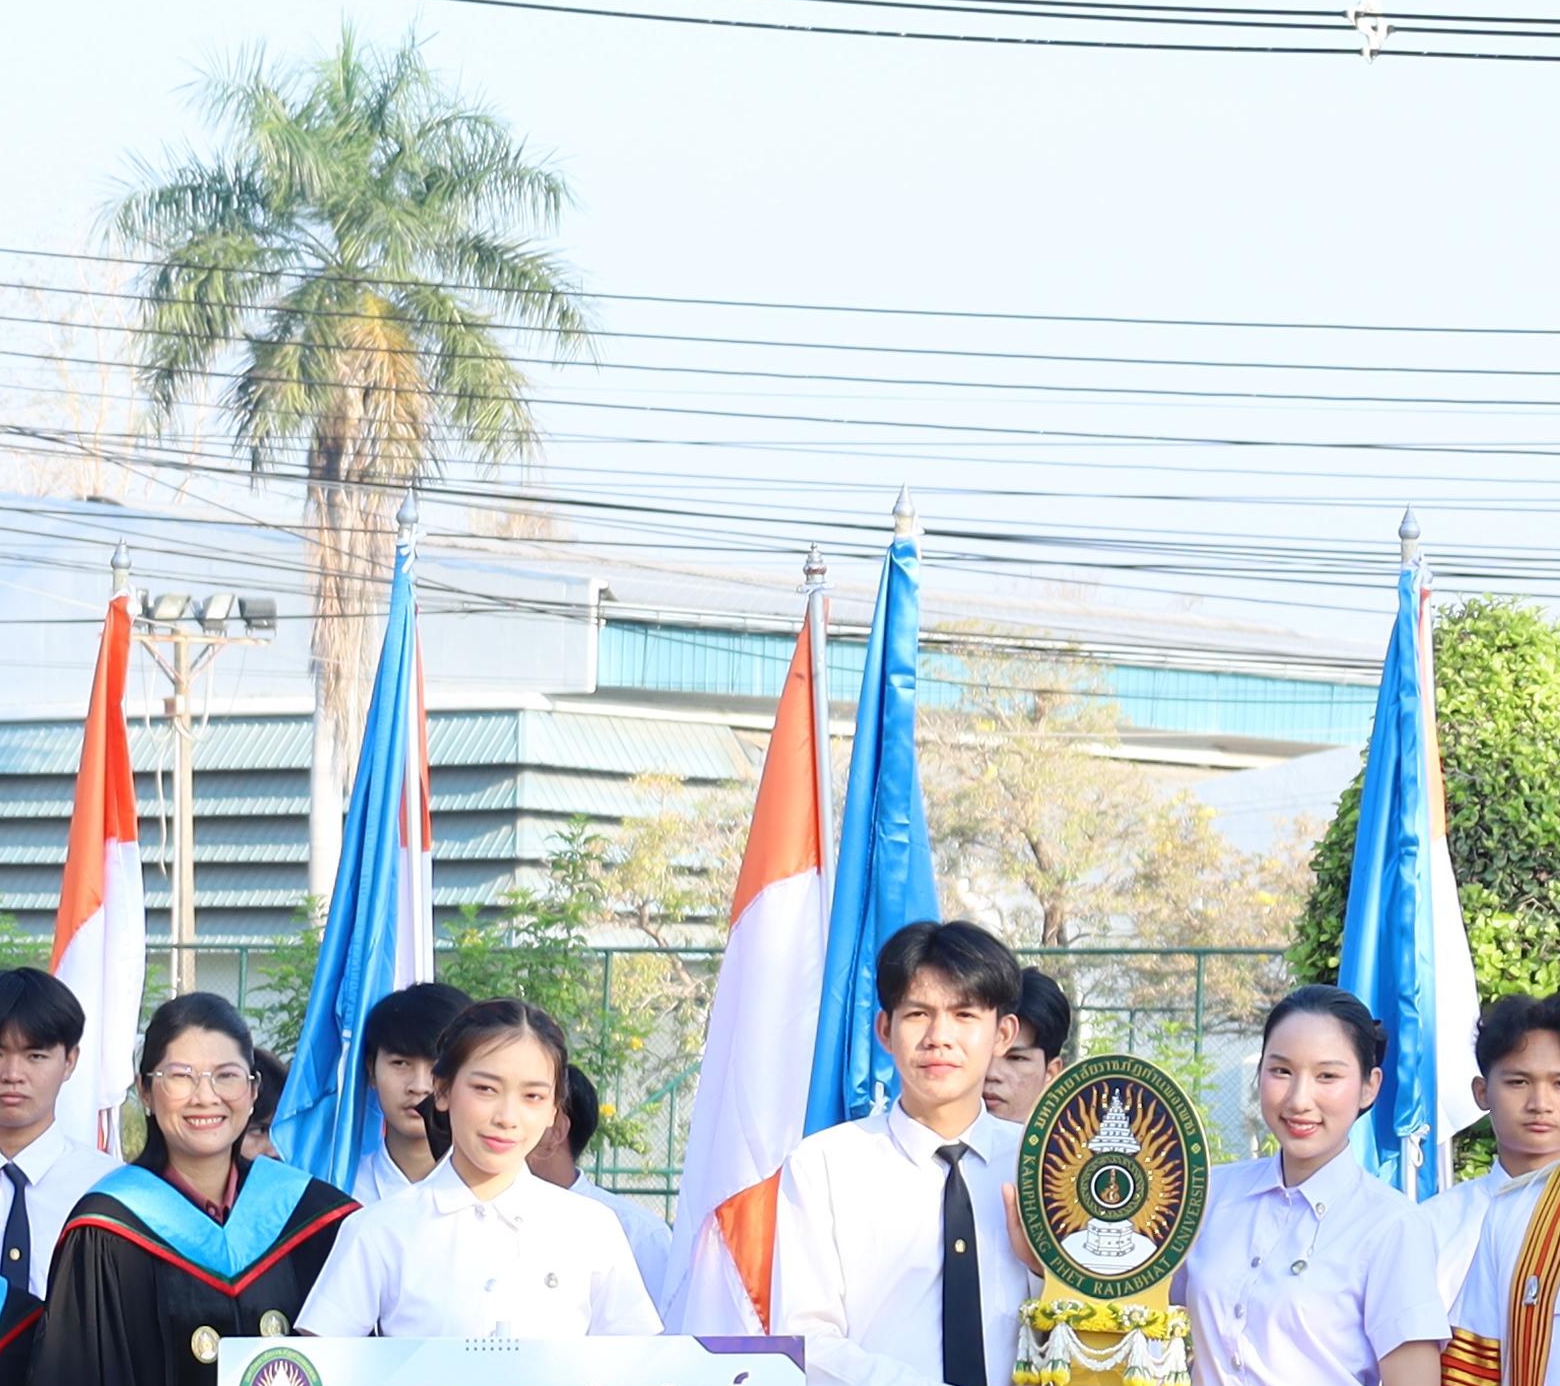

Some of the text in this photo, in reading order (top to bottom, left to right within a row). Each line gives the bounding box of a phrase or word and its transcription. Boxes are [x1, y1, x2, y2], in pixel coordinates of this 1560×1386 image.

[1022, 1154, 1206, 1296] KAMPHAENG PHET RAJABHAT UNIVERSITY
